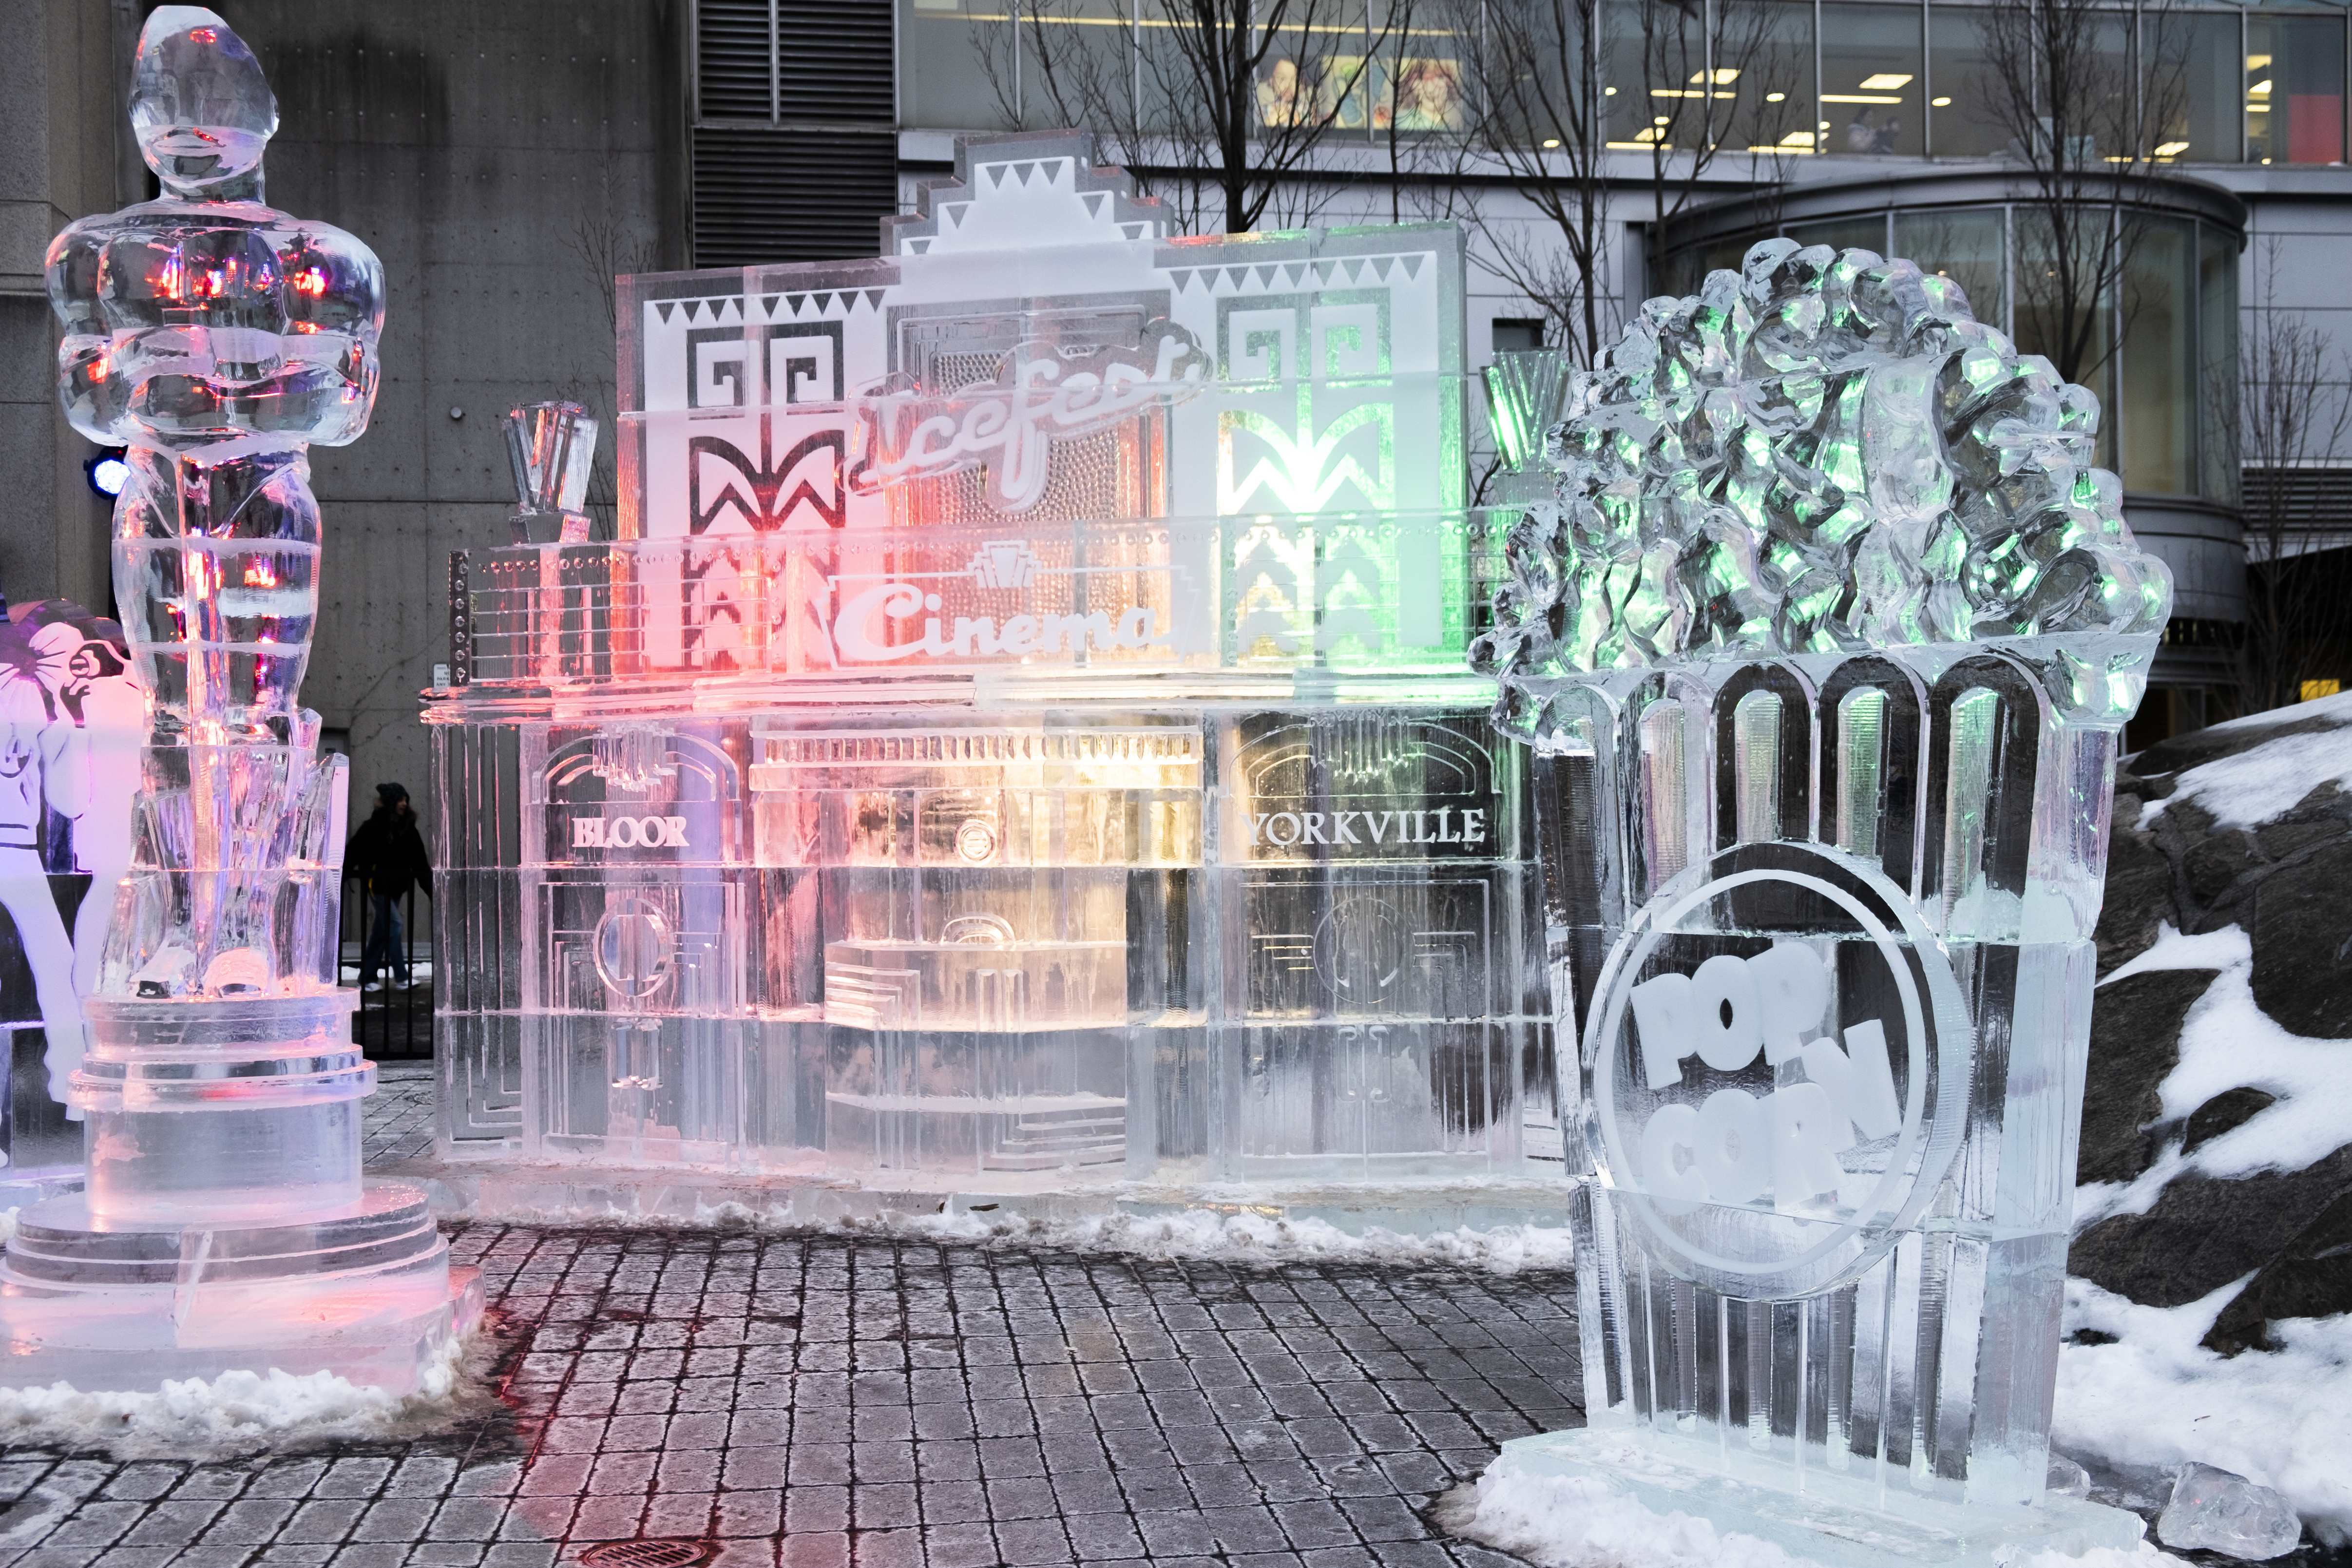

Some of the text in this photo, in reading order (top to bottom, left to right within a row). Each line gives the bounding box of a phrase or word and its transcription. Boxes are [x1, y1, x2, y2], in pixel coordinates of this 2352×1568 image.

[834, 583, 1179, 661] Cinema
[572, 816, 689, 847] BLOOR
[1240, 808, 1485, 845] YORKVILLE
[1630, 942, 1828, 1090] POP
[1642, 1018, 1902, 1216] CORN
